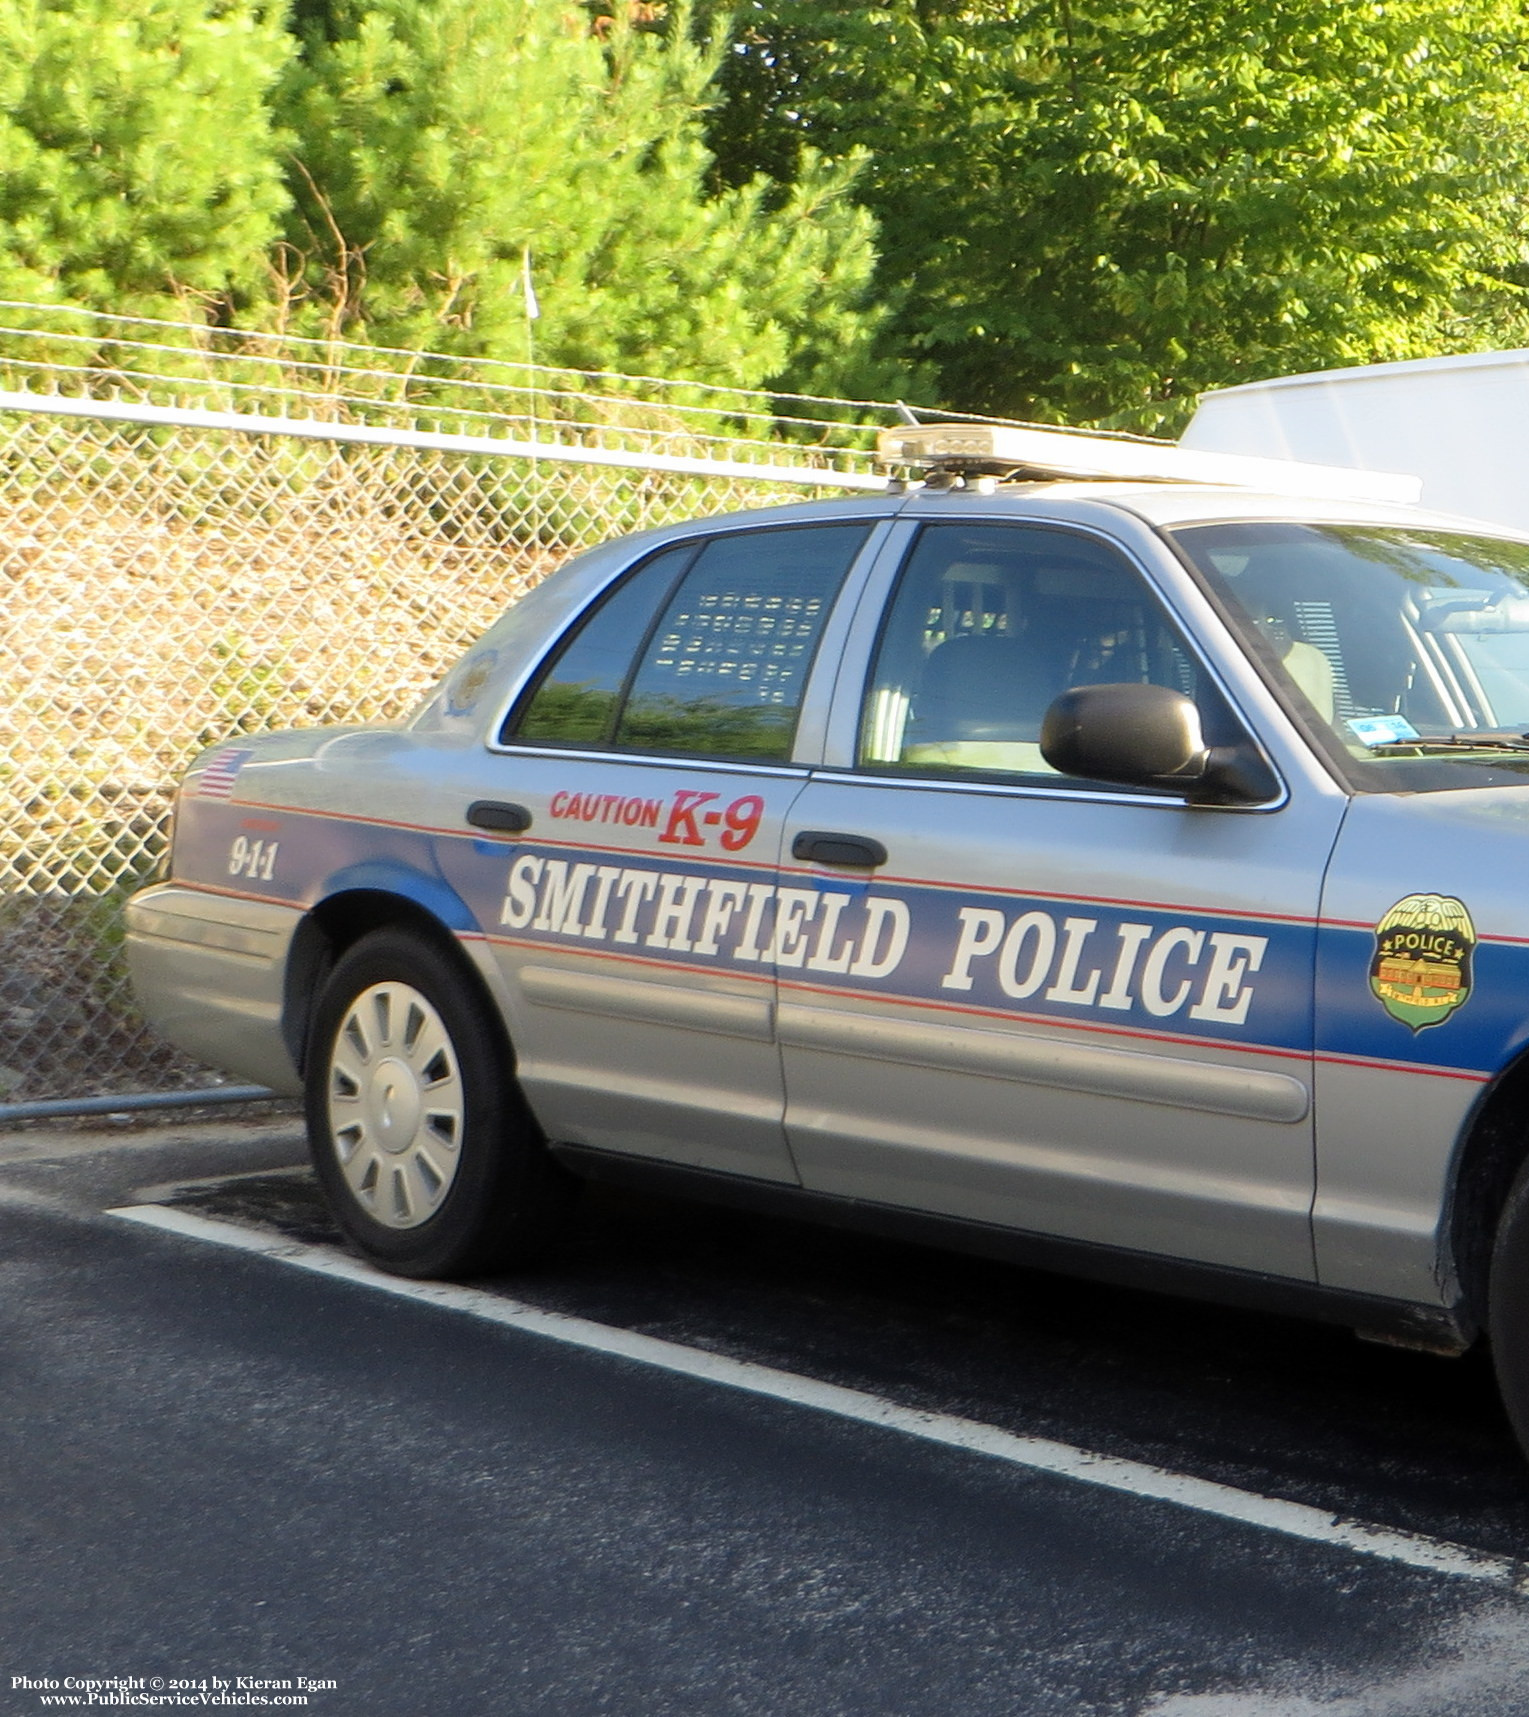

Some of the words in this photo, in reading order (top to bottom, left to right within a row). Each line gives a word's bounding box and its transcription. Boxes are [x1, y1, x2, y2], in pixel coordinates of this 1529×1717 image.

[550, 790, 664, 827] CAUTION
[658, 789, 765, 851] K-9
[500, 854, 911, 979] SMITHFIELD
[941, 906, 1269, 1025] POLICE
[1394, 933, 1456, 955] POLICE
